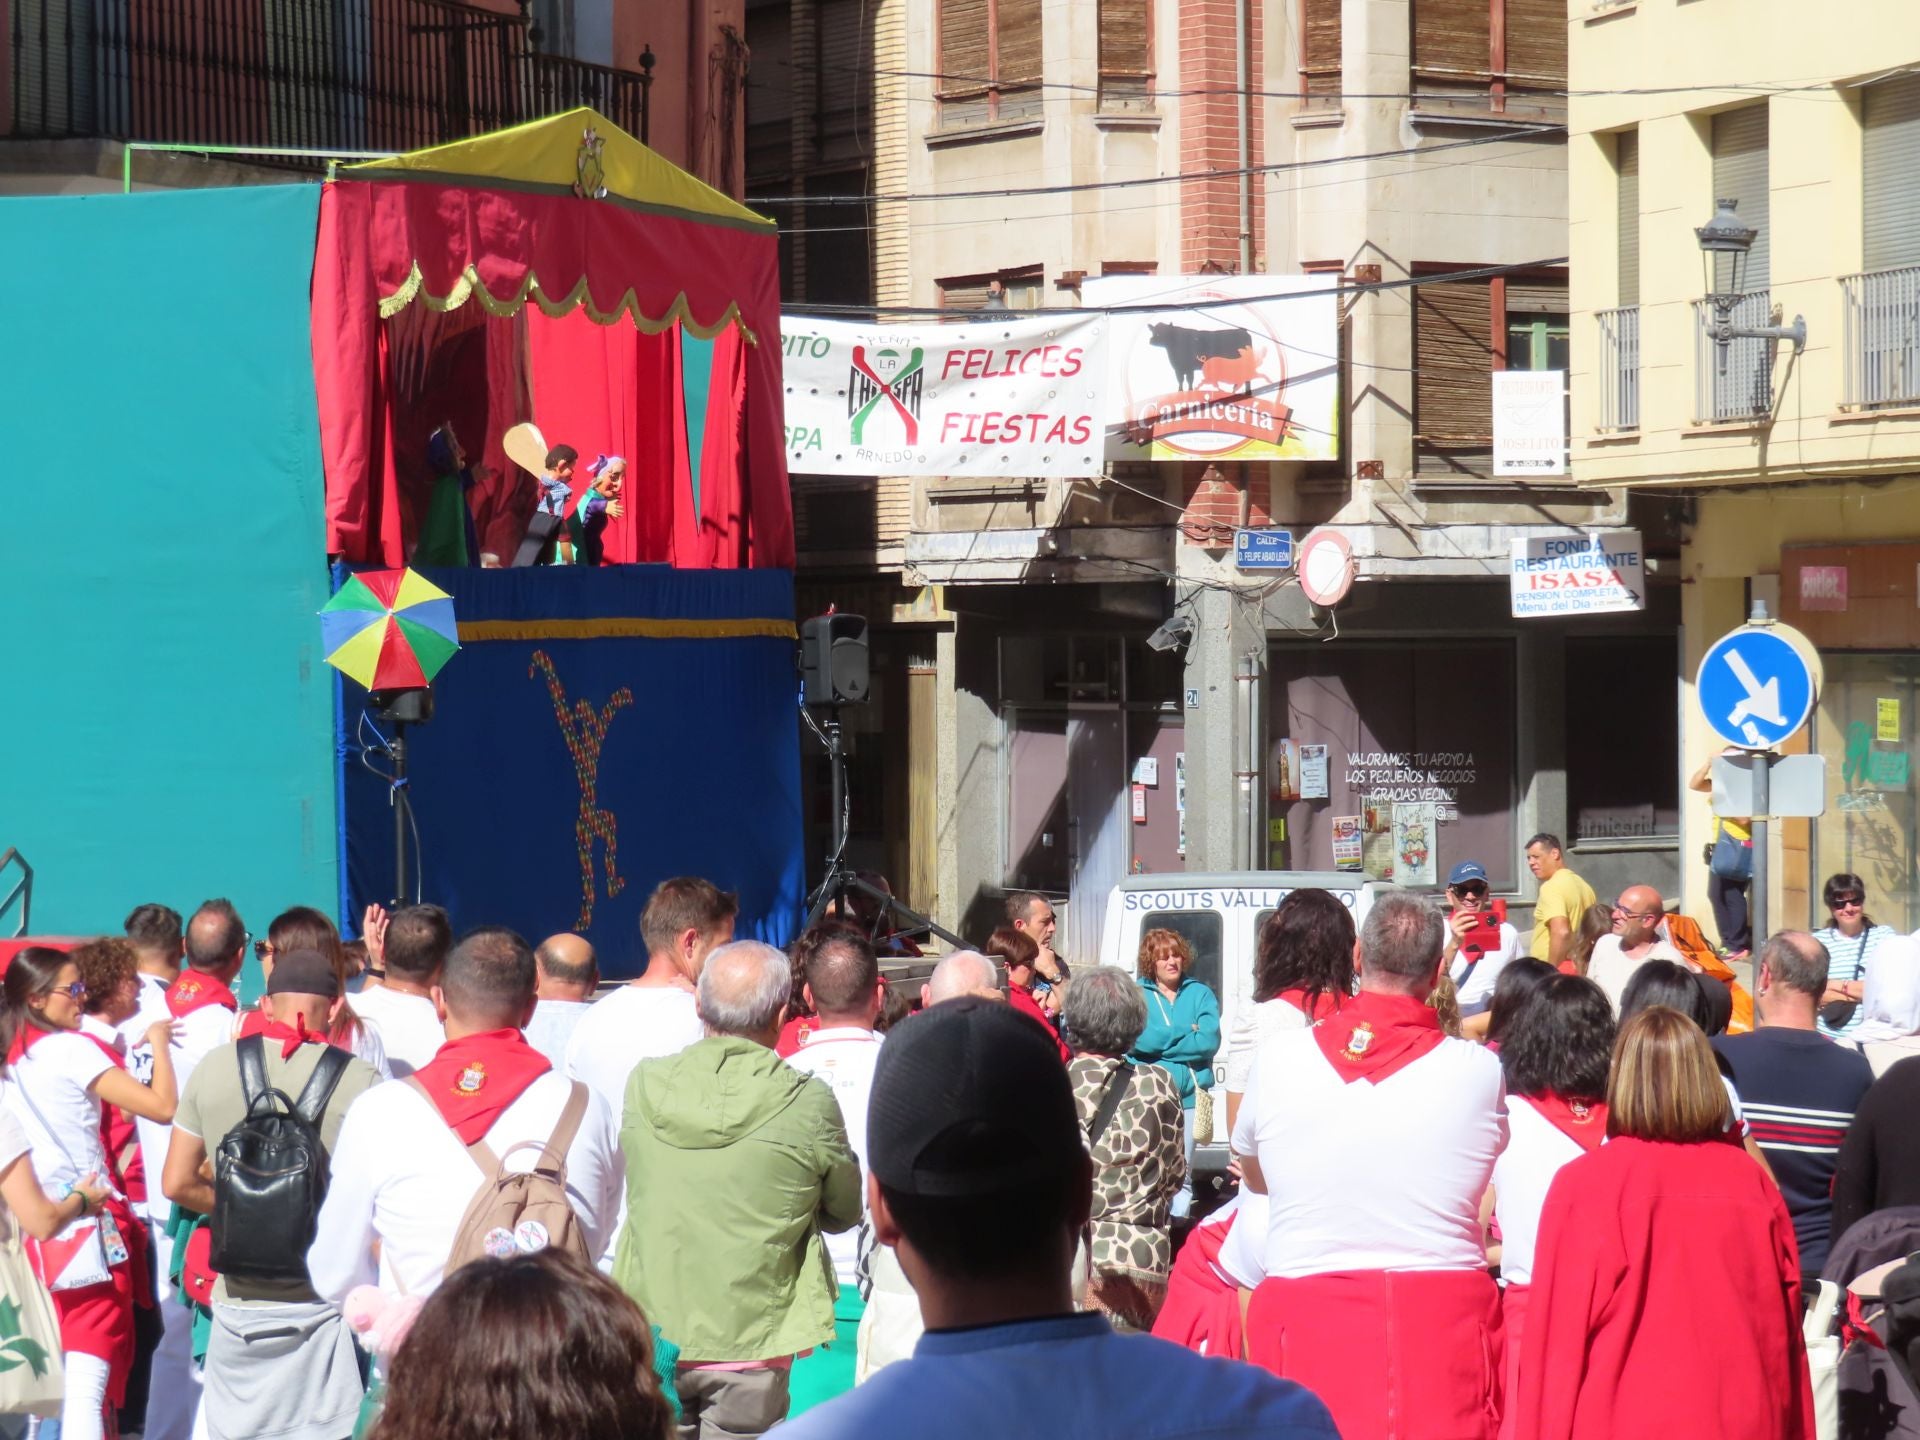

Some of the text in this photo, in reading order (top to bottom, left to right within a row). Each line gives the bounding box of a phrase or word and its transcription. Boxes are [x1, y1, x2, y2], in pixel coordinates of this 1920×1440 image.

[879, 360, 896, 369] LA
[941, 345, 1084, 380] FELICES
[1138, 394, 1274, 431] Carnicería
[940, 411, 1092, 445] FIESTAS
[856, 448, 913, 463] ARNEDO
[1256, 536, 1277, 545] CALLE
[1545, 539, 1605, 555] FONDA
[1245, 552, 1261, 561] FELIPE
[1261, 552, 1275, 561] ABAD
[1514, 552, 1638, 572] RESTAURANTE
[1530, 569, 1626, 590] ISASA
[1516, 587, 1619, 602] PENSION COMPLETA
[1551, 601, 1568, 610] del
[1187, 691, 1197, 705] 21
[1347, 752, 1474, 766] VALORAMOS TU APOYO A
[1345, 770, 1366, 784] LOS
[1369, 767, 1424, 784] PEQUEÑOS
[1427, 769, 1476, 784] NEGOCIOS
[1125, 892, 1213, 910] SCOUTS
